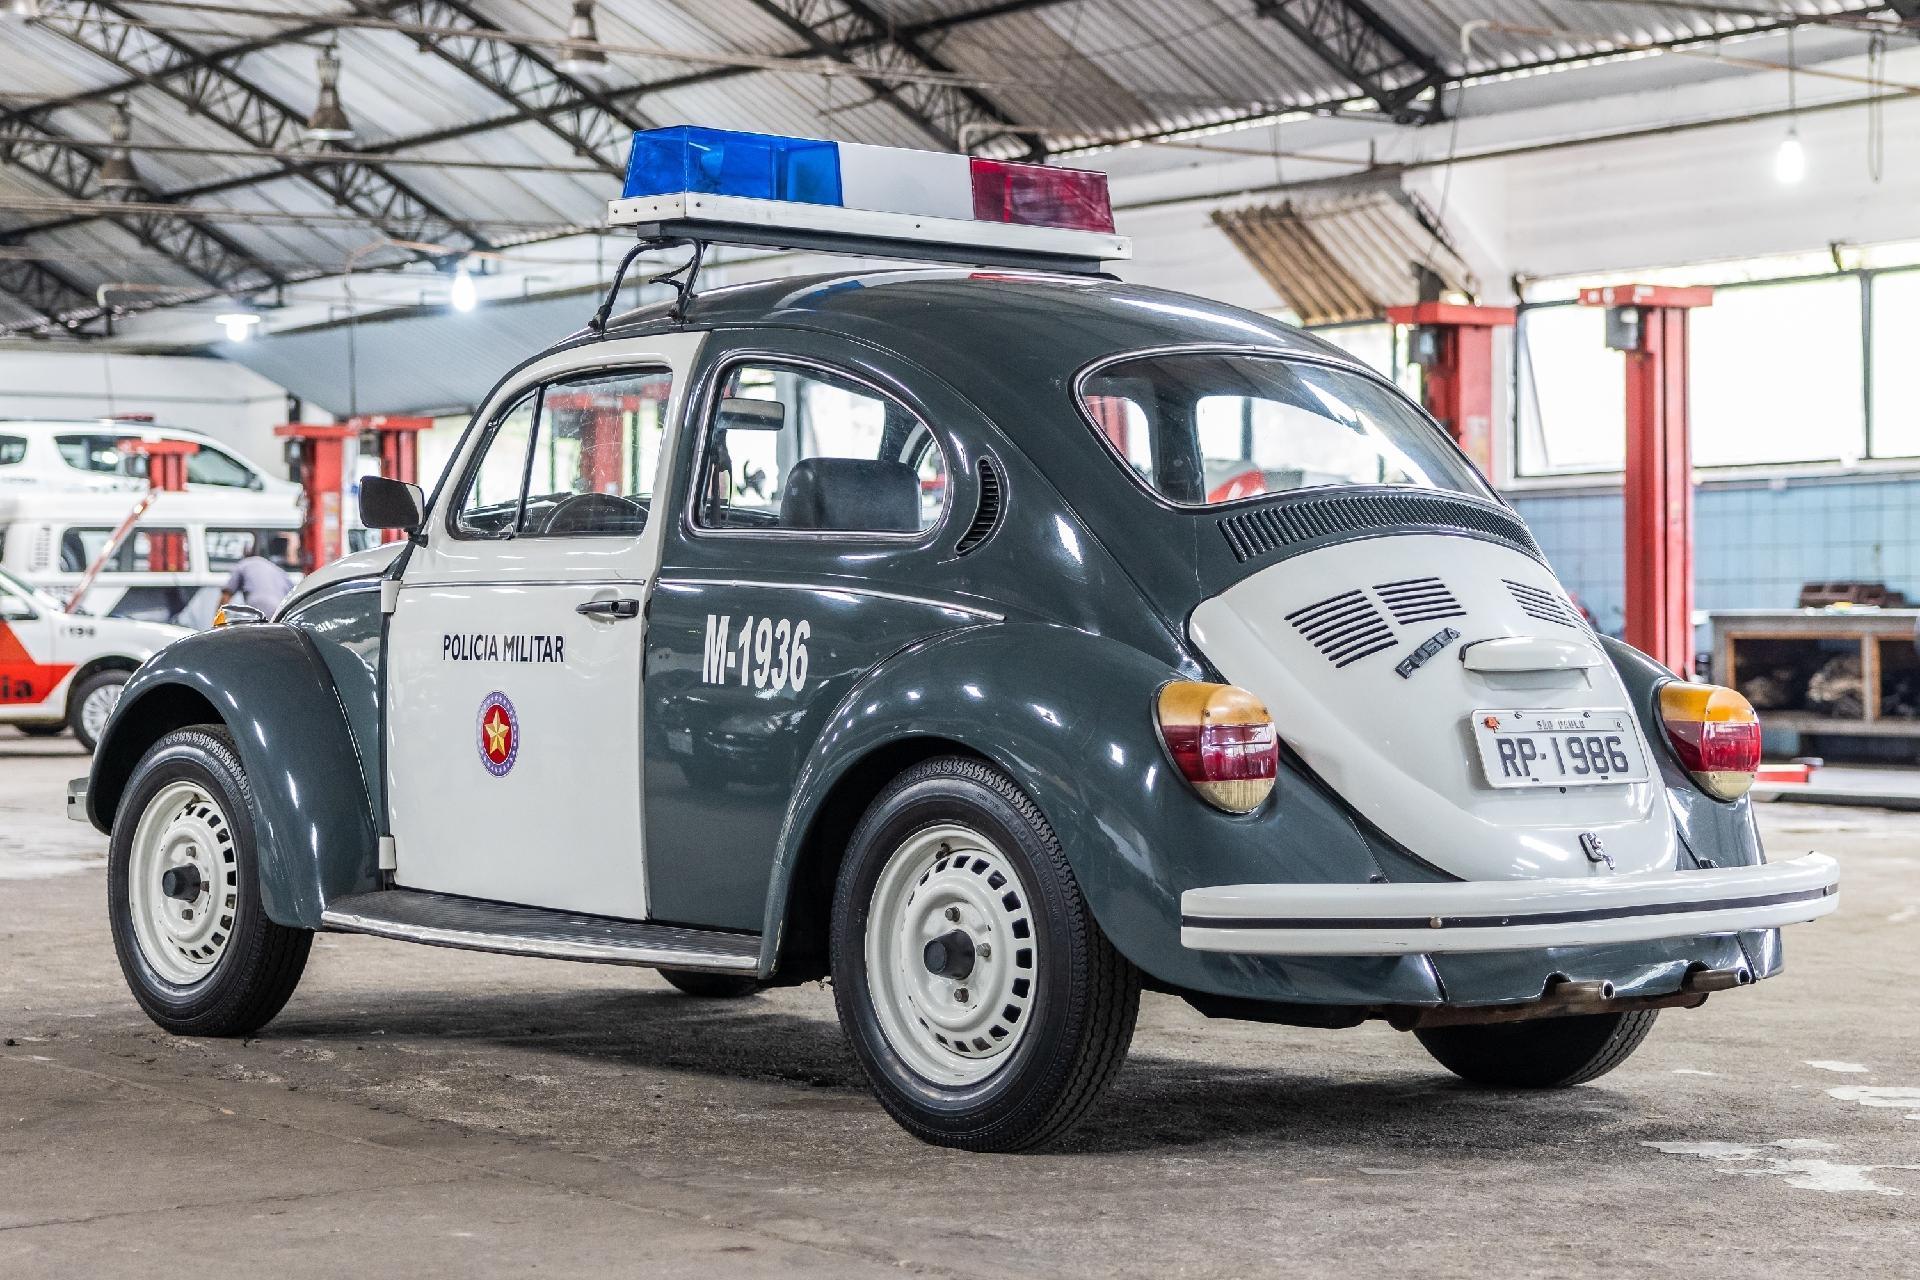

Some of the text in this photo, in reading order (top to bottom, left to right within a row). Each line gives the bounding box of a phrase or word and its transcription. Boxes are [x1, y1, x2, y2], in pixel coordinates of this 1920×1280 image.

[443, 634, 564, 663] POLICIA MILITAR
[703, 615, 811, 692] M-1936
